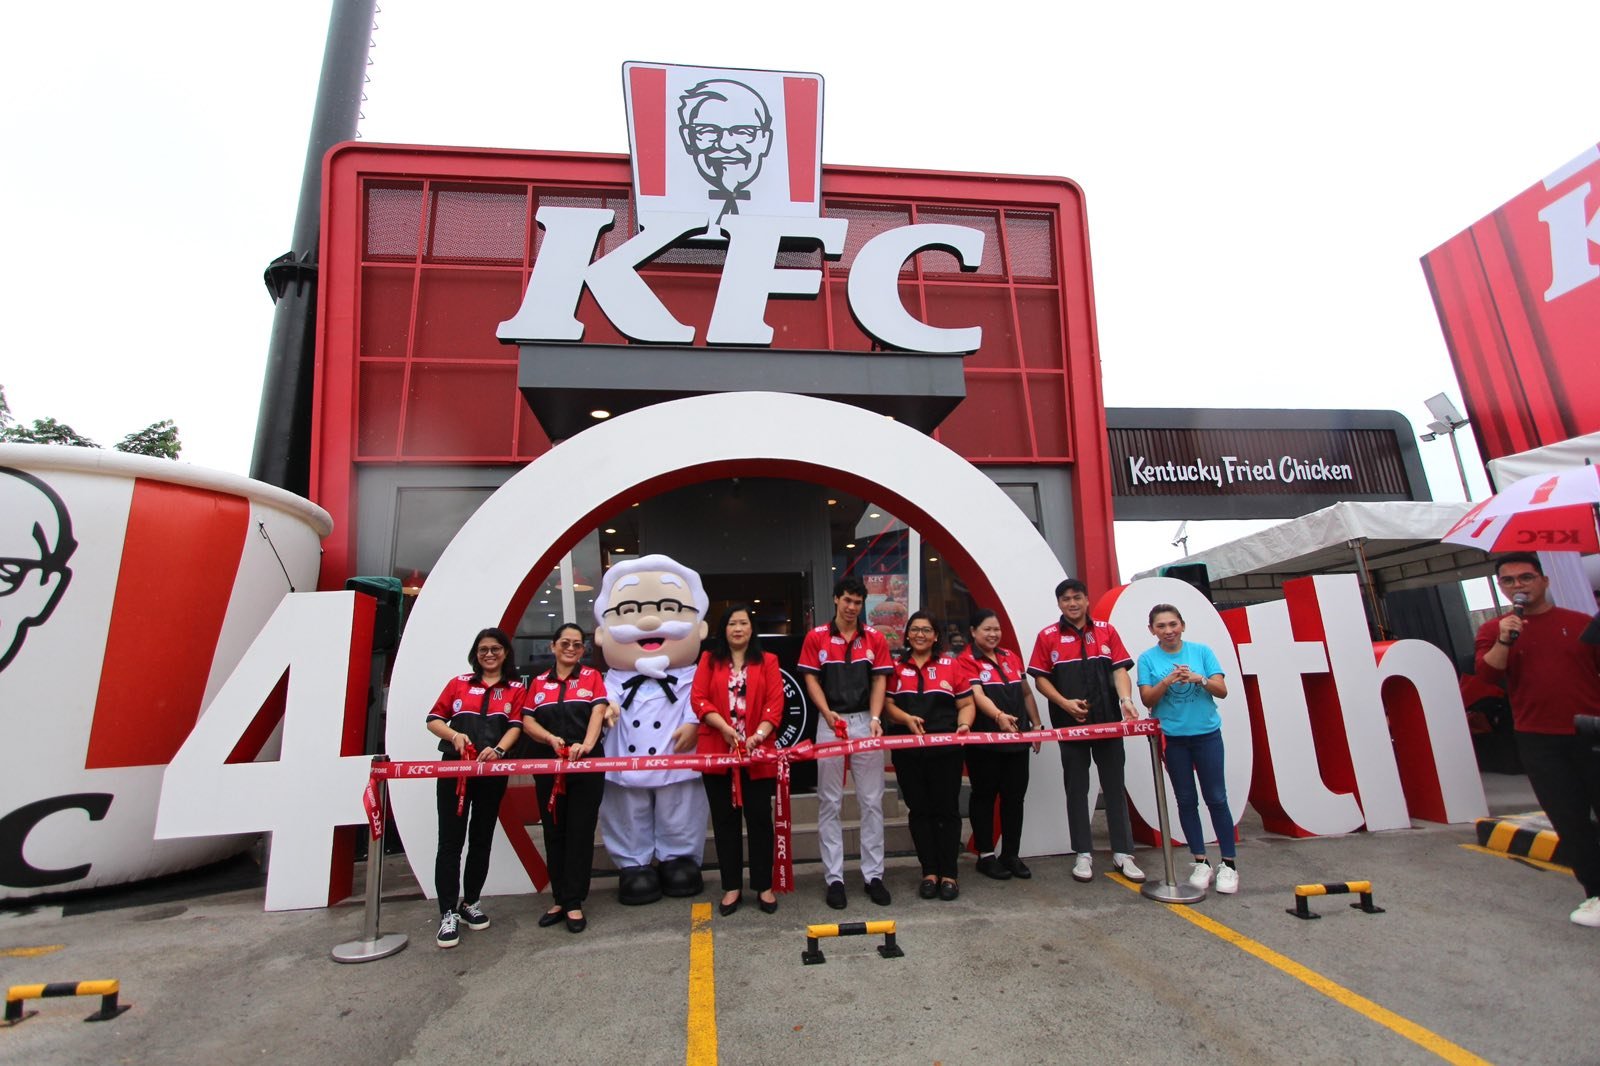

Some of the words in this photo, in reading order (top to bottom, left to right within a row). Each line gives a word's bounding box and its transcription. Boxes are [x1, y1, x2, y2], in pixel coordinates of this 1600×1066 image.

[495, 206, 986, 354] KFC
[1128, 456, 1223, 488] Kentucky
[1221, 456, 1276, 484] Fried
[1279, 455, 1353, 483] Chicken
[1134, 723, 1155, 732] KFC
[997, 732, 1020, 740] KFC
[1068, 728, 1090, 737] KFC
[859, 738, 881, 749] KFC
[930, 735, 952, 743] KFC
[751, 749, 765, 759] FC
[567, 760, 592, 769] KFC
[645, 758, 669, 767] KFC
[716, 757, 740, 765] KFC
[407, 765, 434, 775] KFC
[490, 763, 517, 772] KFC
[371, 810, 380, 836] KFC
[777, 834, 786, 859] KFC
